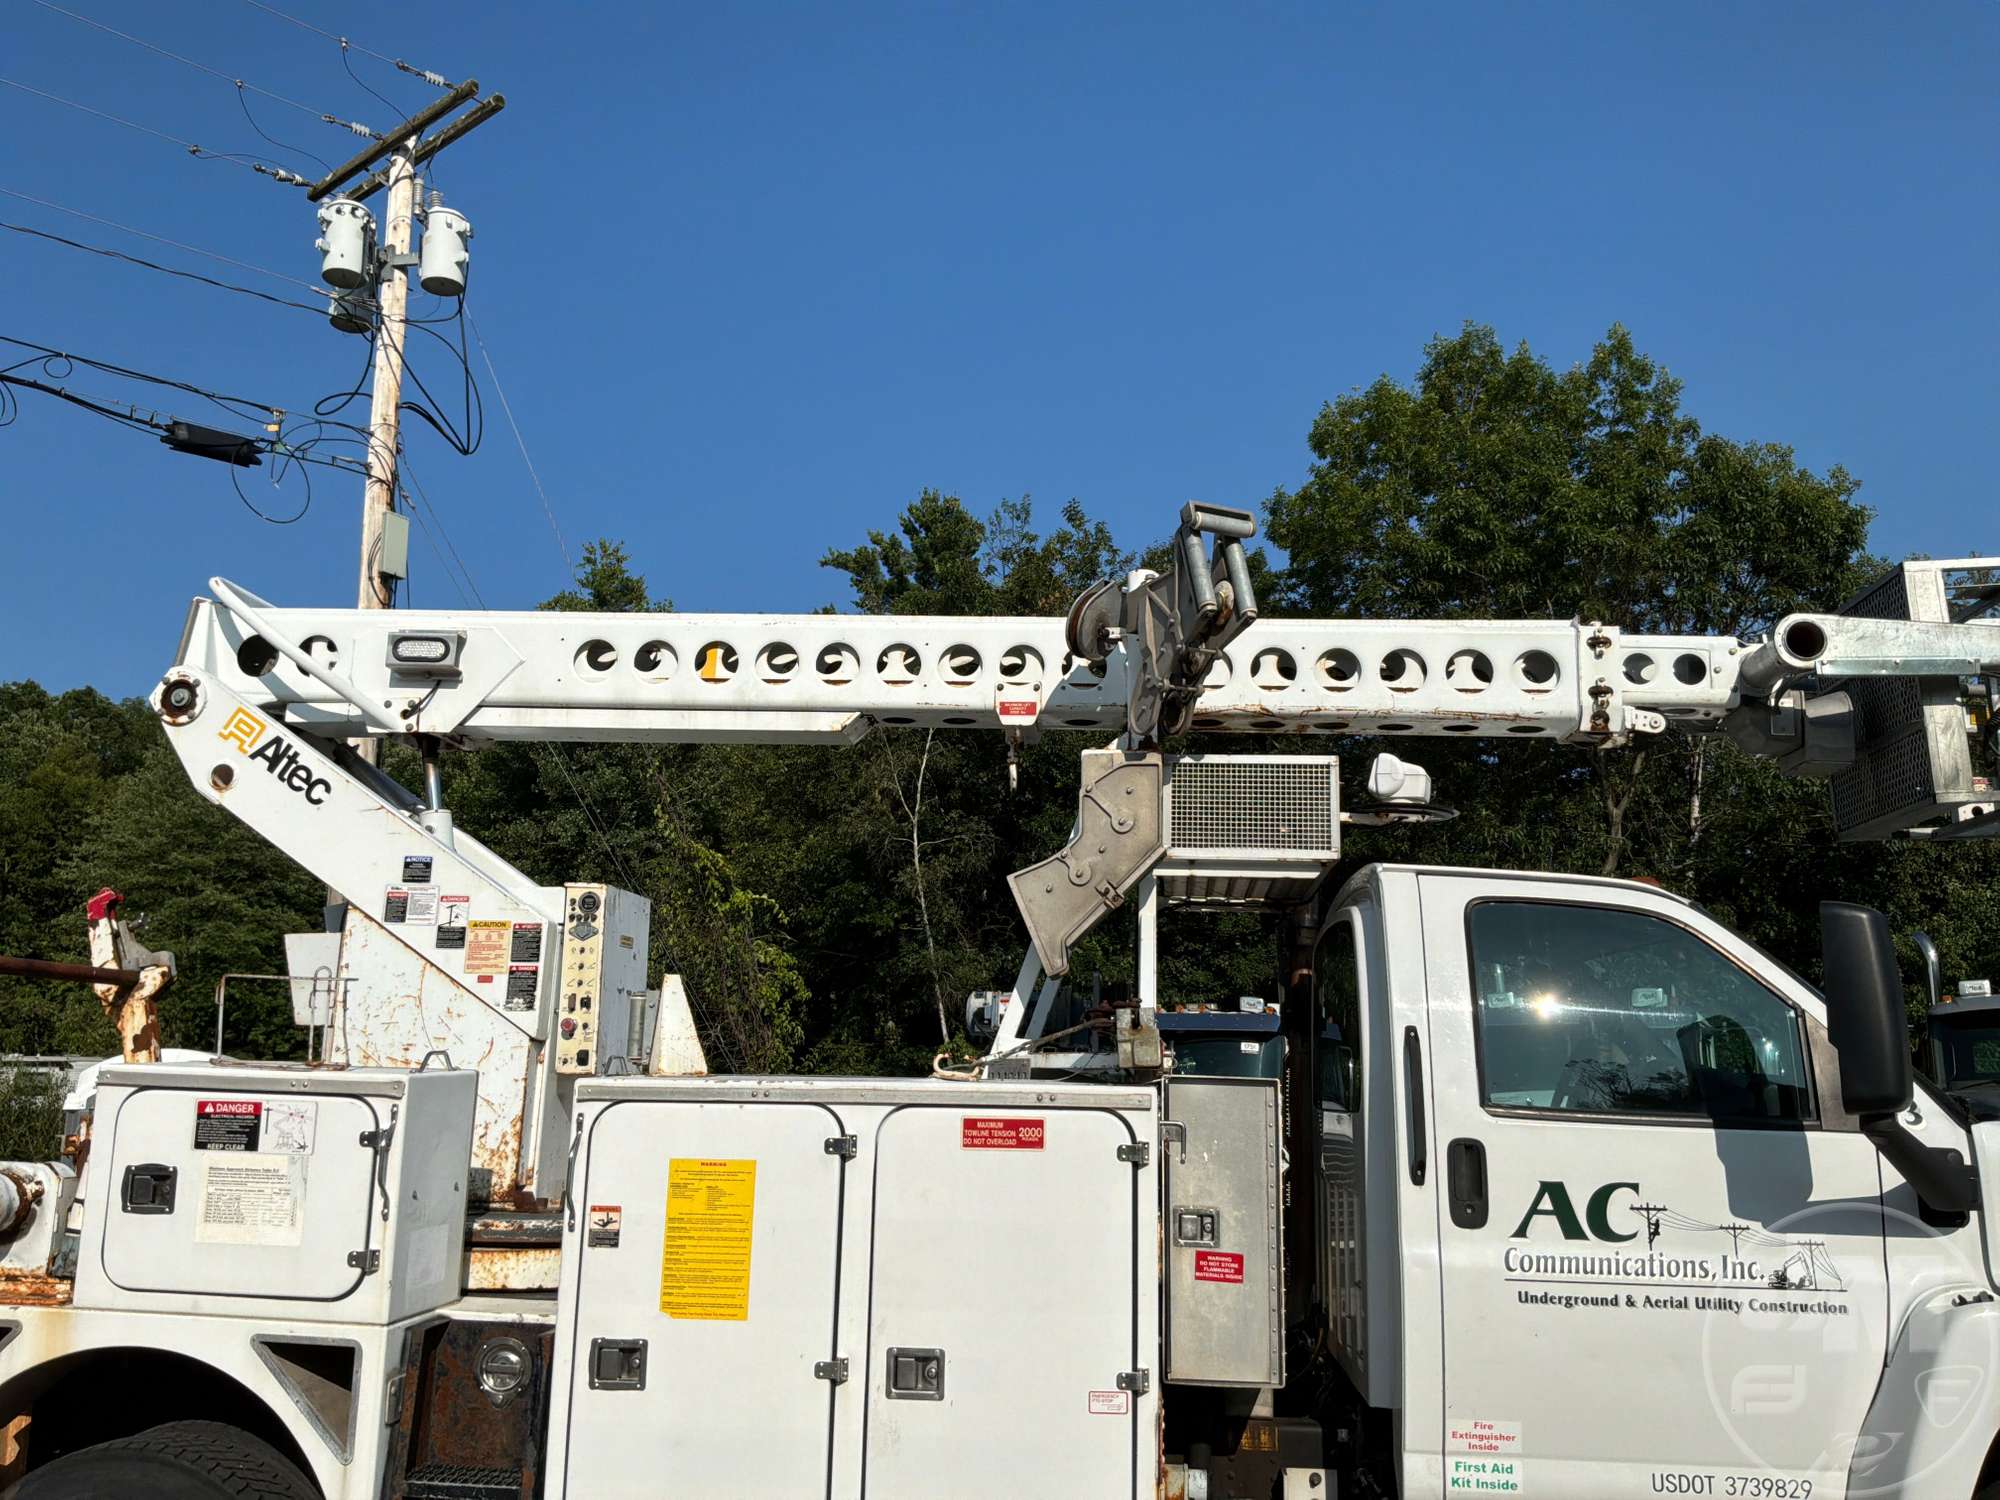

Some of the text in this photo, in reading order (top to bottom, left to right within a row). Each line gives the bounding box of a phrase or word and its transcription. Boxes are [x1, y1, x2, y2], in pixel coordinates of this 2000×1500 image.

[248, 735, 332, 805] Altec
[216, 1103, 254, 1113] DANGER
[965, 1129, 1016, 1138] TOWLINE TENSION
[1019, 1127, 1042, 1137] 2000
[225, 1143, 246, 1151] CLEAR
[986, 1138, 1017, 1146] OVERLOAD
[1508, 1180, 1640, 1243] AC
[1504, 1247, 1765, 1281] Communications, Inc.
[1517, 1290, 1848, 1315] Underground & Aerial Utility Construction
[1473, 1421, 1494, 1430] Fire
[1451, 1431, 1517, 1442] Extinguisher
[1468, 1442, 1499, 1451] Inside
[1455, 1461, 1513, 1474] First Aid
[1451, 1477, 1519, 1491] Kit Inside
[1652, 1473, 1813, 1500] USDOT 3739829
